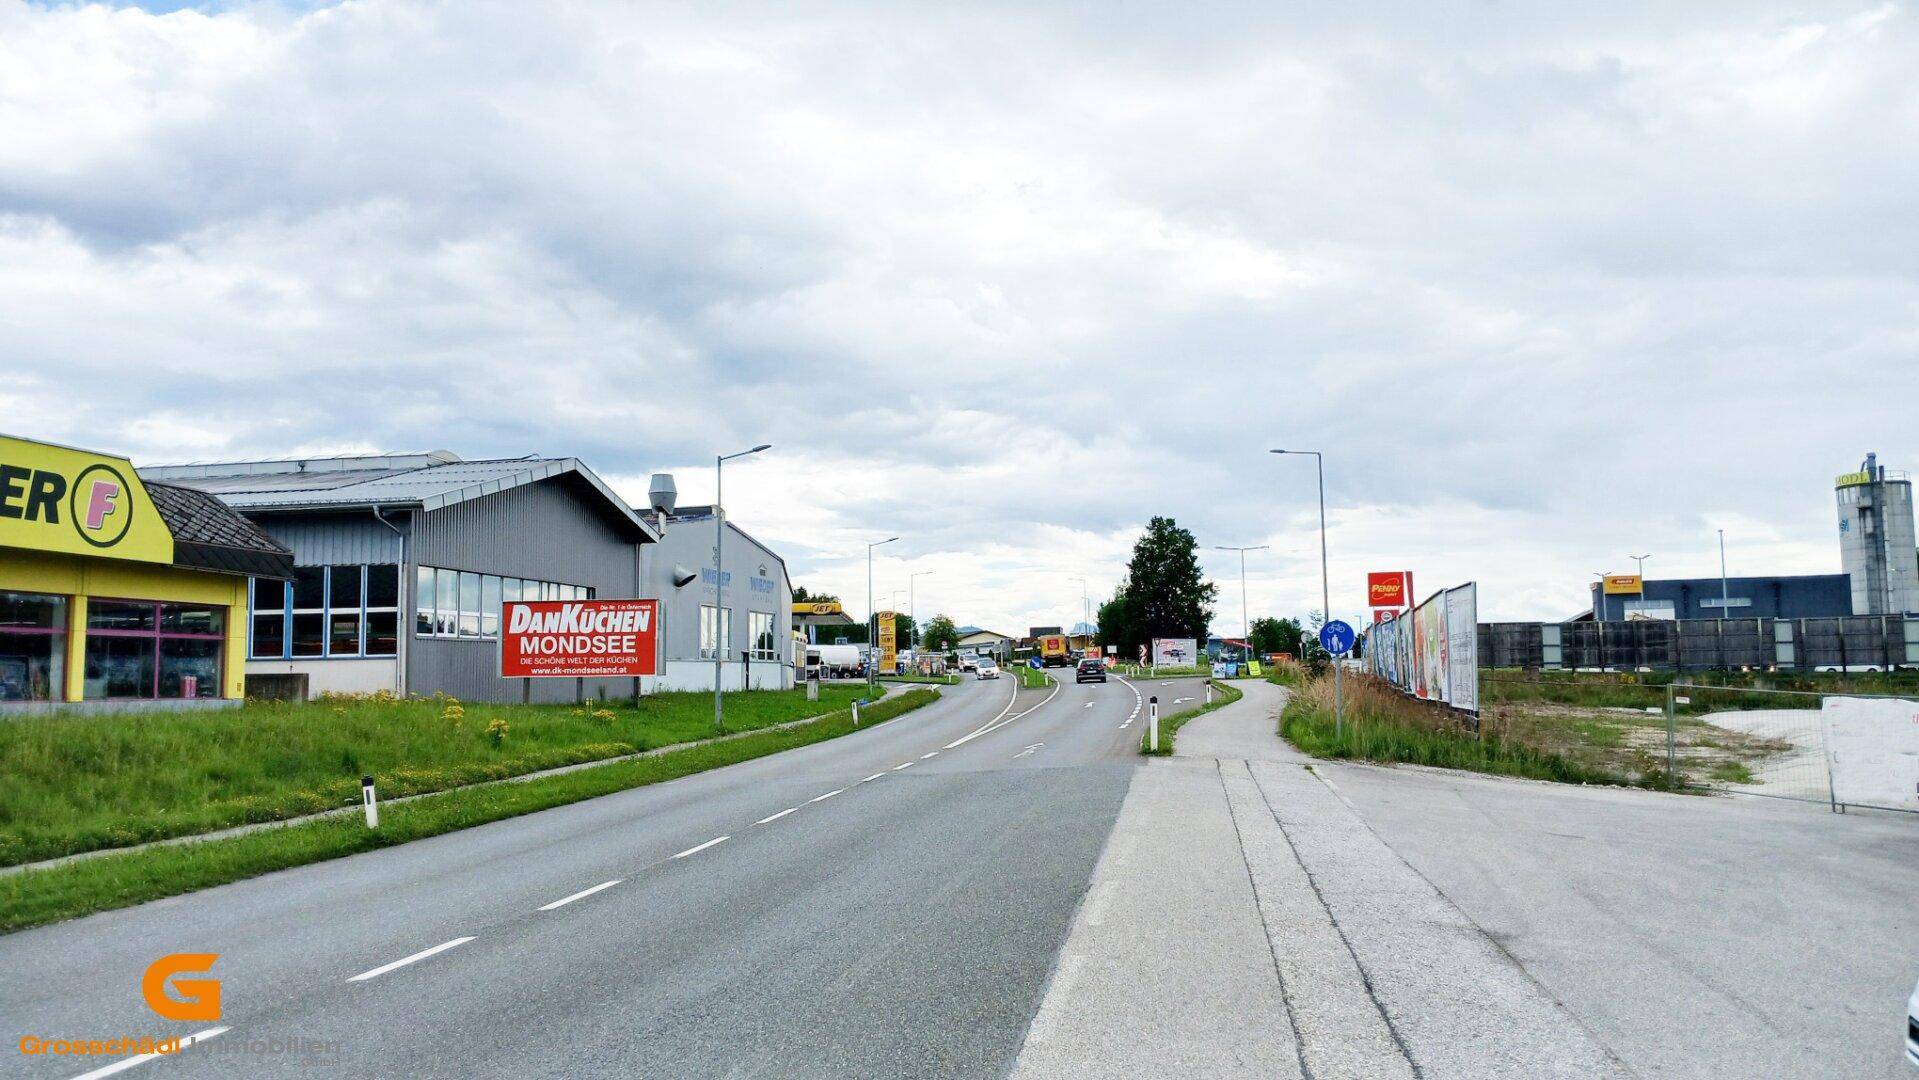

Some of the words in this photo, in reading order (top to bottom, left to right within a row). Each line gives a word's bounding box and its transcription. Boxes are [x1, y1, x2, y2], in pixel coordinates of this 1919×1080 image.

[815, 605, 830, 613] JET
[521, 636, 636, 654] MONDSEE
[520, 657, 534, 665] DIE
[534, 656, 566, 665] SCHÖNE
[606, 656, 638, 664] KÜCHEN
[531, 666, 627, 675] www.dk-mondseeland.at
